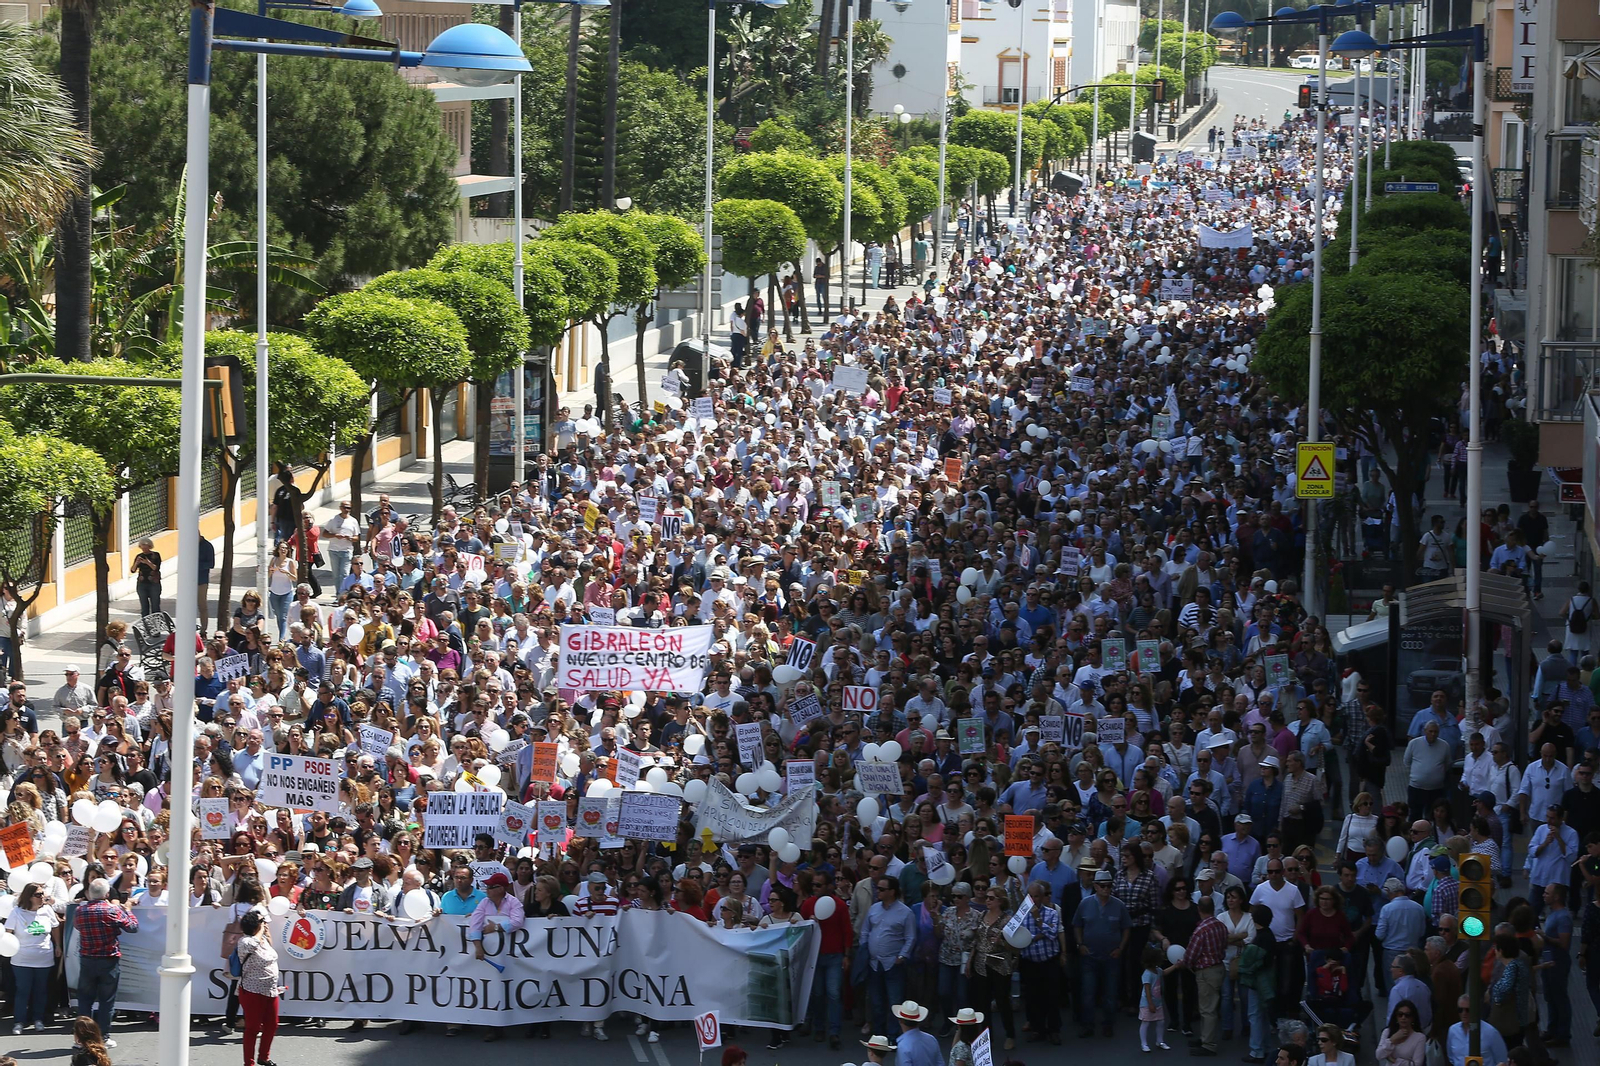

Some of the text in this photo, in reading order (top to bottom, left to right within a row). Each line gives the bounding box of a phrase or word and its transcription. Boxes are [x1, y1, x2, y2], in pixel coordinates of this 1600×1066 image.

[662, 517, 680, 538] NO
[567, 652, 706, 669] NUEVO CENTRO DE
[787, 639, 813, 670] NO
[566, 667, 632, 688] SALUD
[843, 687, 876, 710] NO
[800, 704, 820, 720] SALUD
[1062, 716, 1080, 746] NO
[270, 756, 331, 776] PP PSOE
[267, 774, 335, 794] NO NOS ENGAÑEIS
[863, 774, 892, 782] SANIDAD
[286, 792, 314, 807] MÁS
[428, 795, 456, 815] HUNDEN
[459, 795, 467, 815] LA
[1006, 820, 1032, 829] RECORTES
[427, 826, 459, 846] FAVORECEN
[462, 826, 468, 846] LA
[1006, 831, 1032, 841] EN SANIDAD
[287, 917, 445, 959] UELVA,
[544, 926, 621, 958] UNA
[208, 966, 695, 1011] SNIDAD PÚBLICA DIGNA
